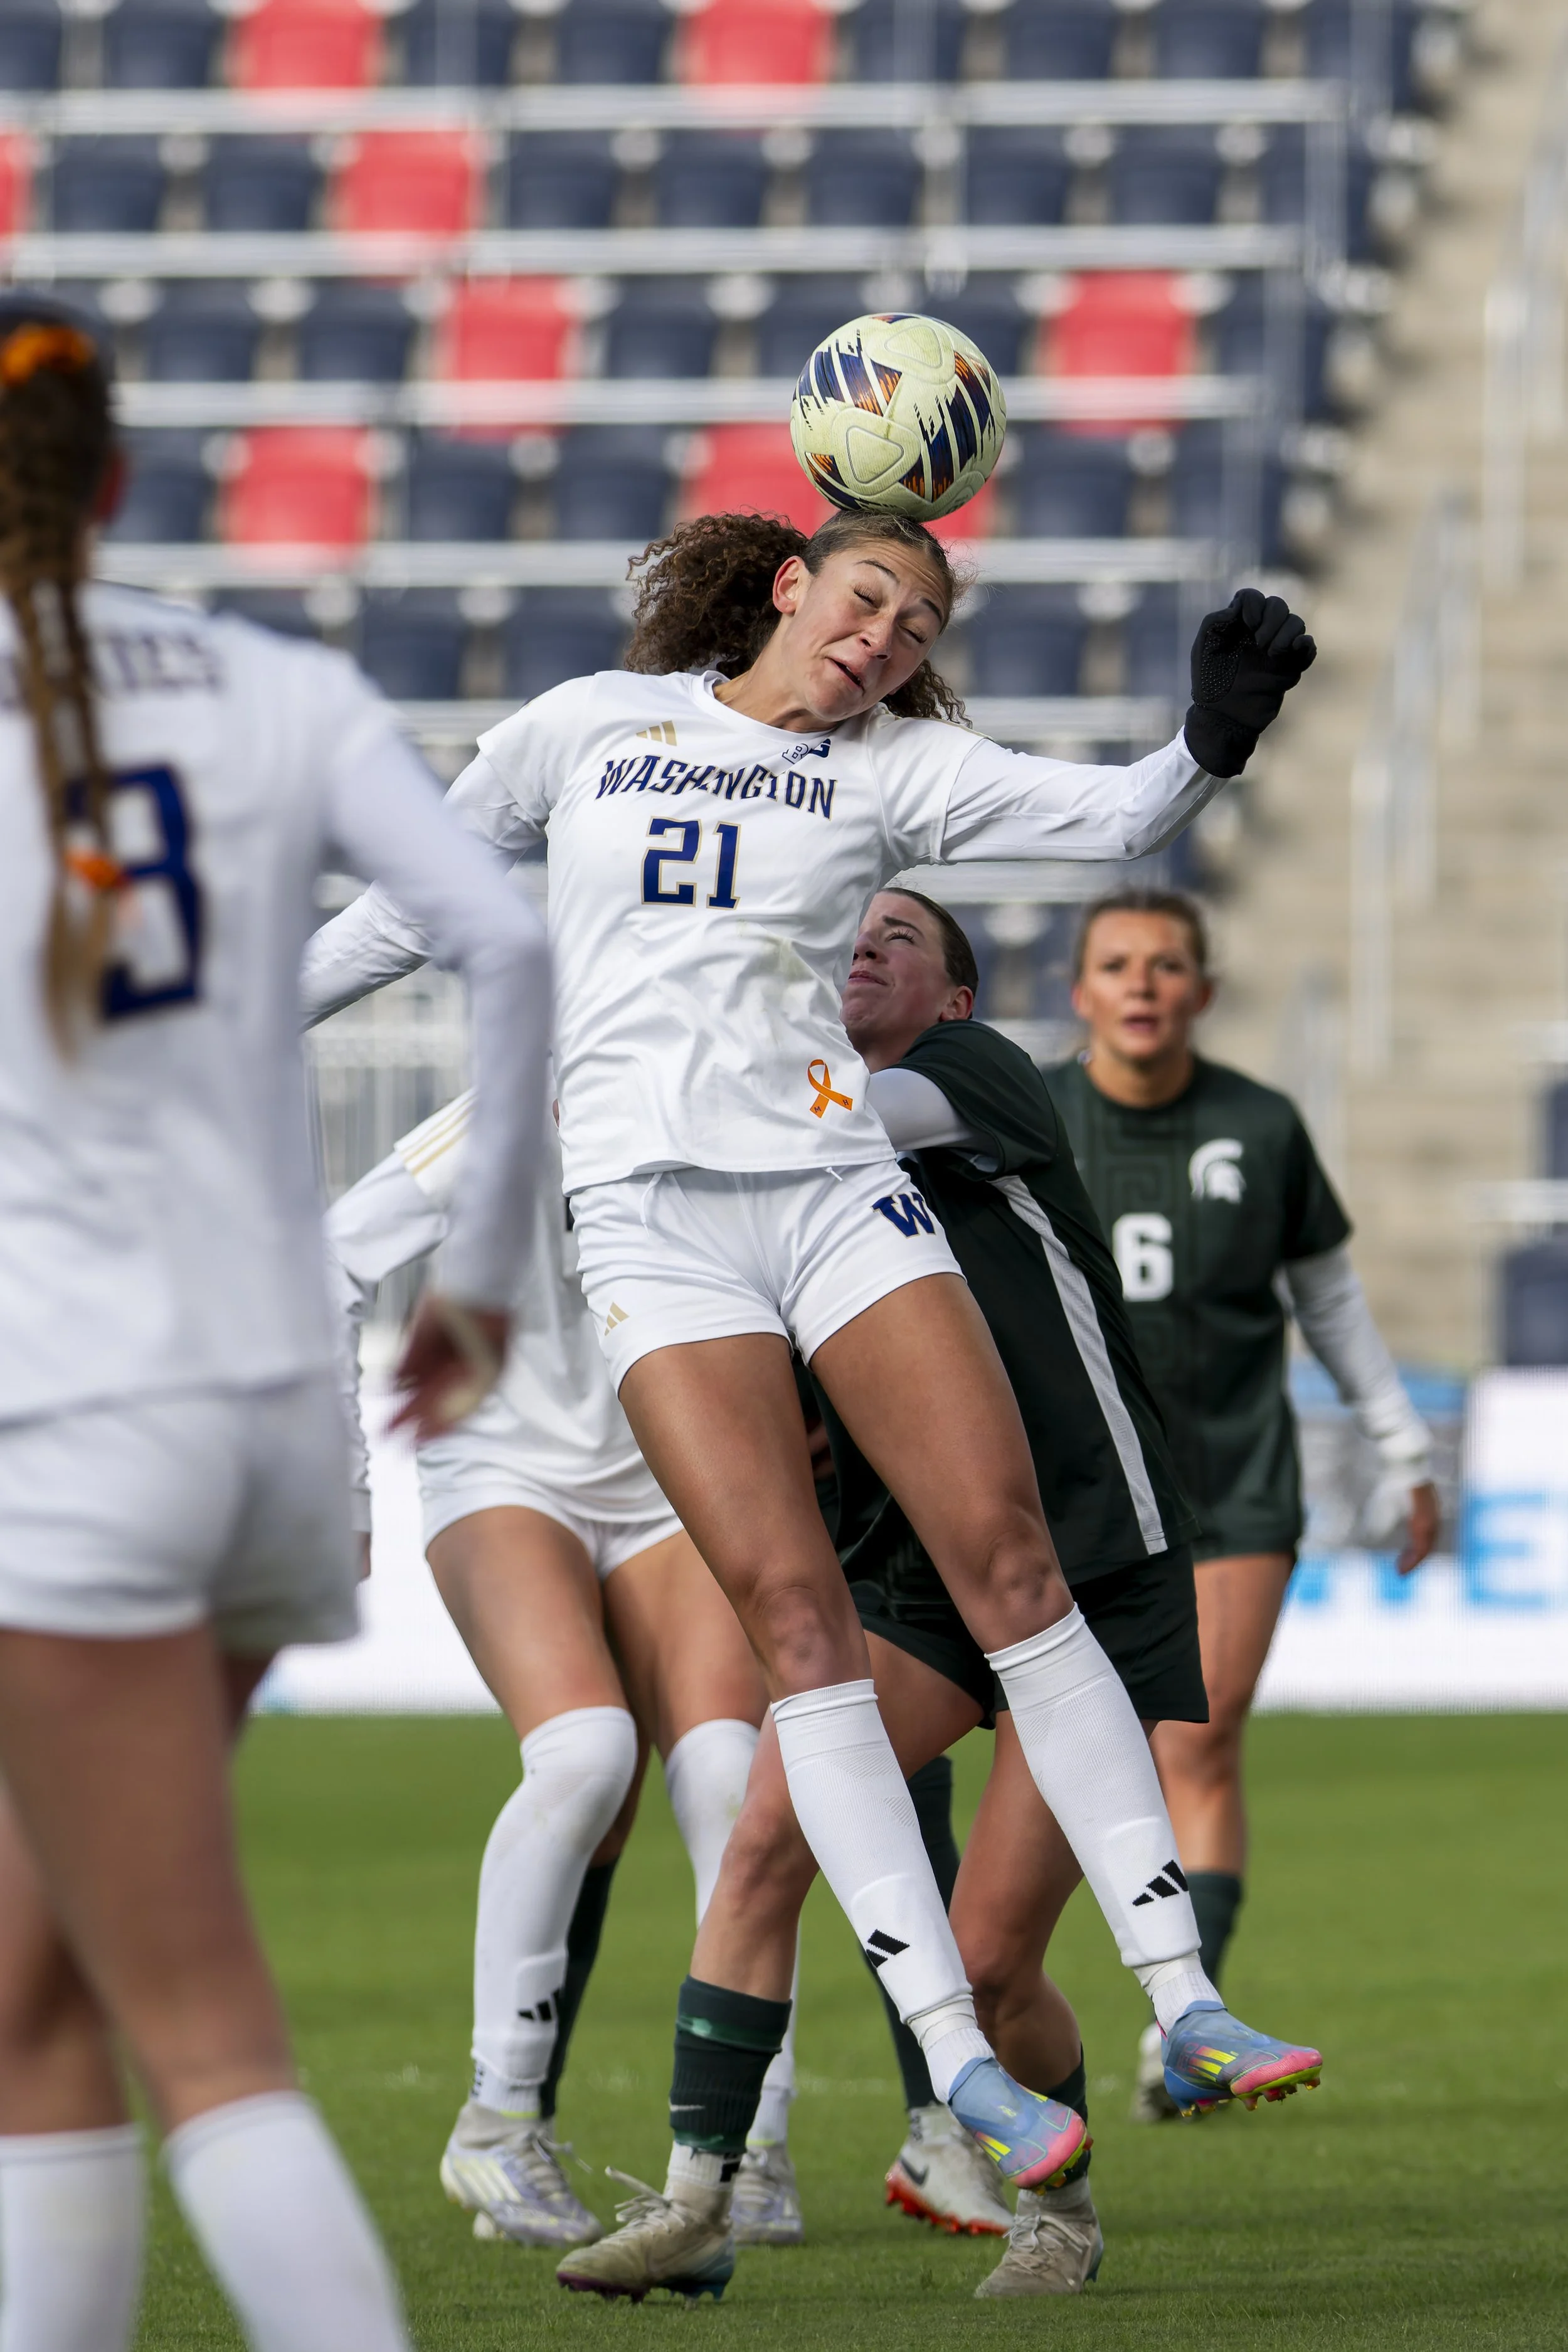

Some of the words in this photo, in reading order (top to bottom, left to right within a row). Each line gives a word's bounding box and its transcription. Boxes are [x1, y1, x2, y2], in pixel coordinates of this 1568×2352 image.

[595, 755, 837, 821] WASHNGTON
[640, 815, 742, 911] 21
[870, 1191, 936, 1239] W
[1113, 1212, 1173, 1301] 6
